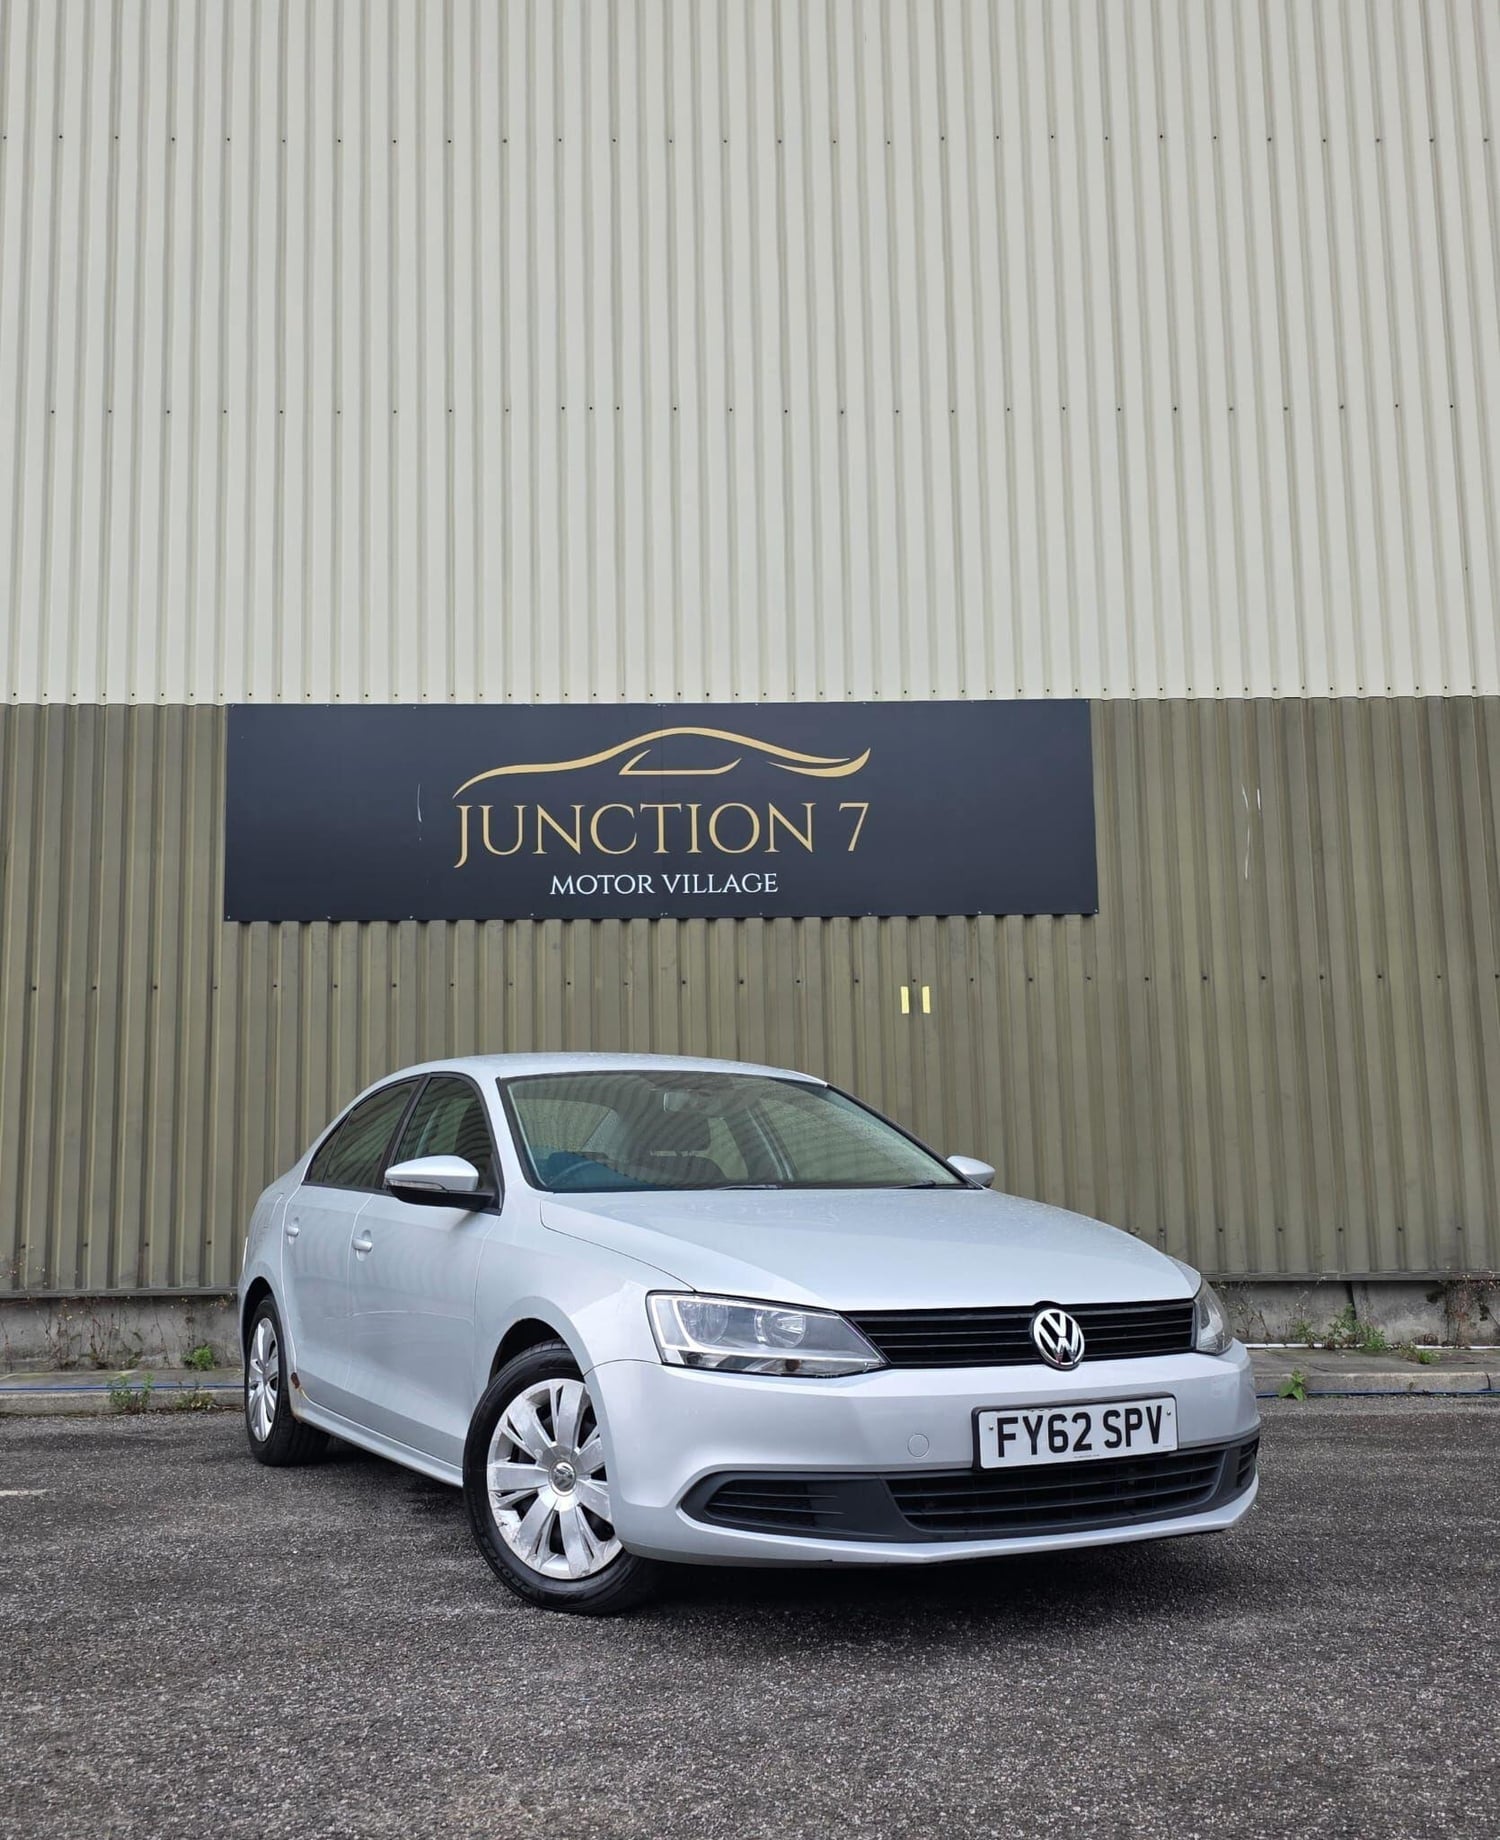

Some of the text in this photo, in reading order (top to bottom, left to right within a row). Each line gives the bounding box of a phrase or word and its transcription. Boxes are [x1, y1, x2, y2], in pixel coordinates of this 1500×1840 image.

[453, 802, 869, 869] JUNCTION 7
[549, 873, 779, 895] MOTOR VILLAGE
[997, 1405, 1162, 1458] FY62 SPV
